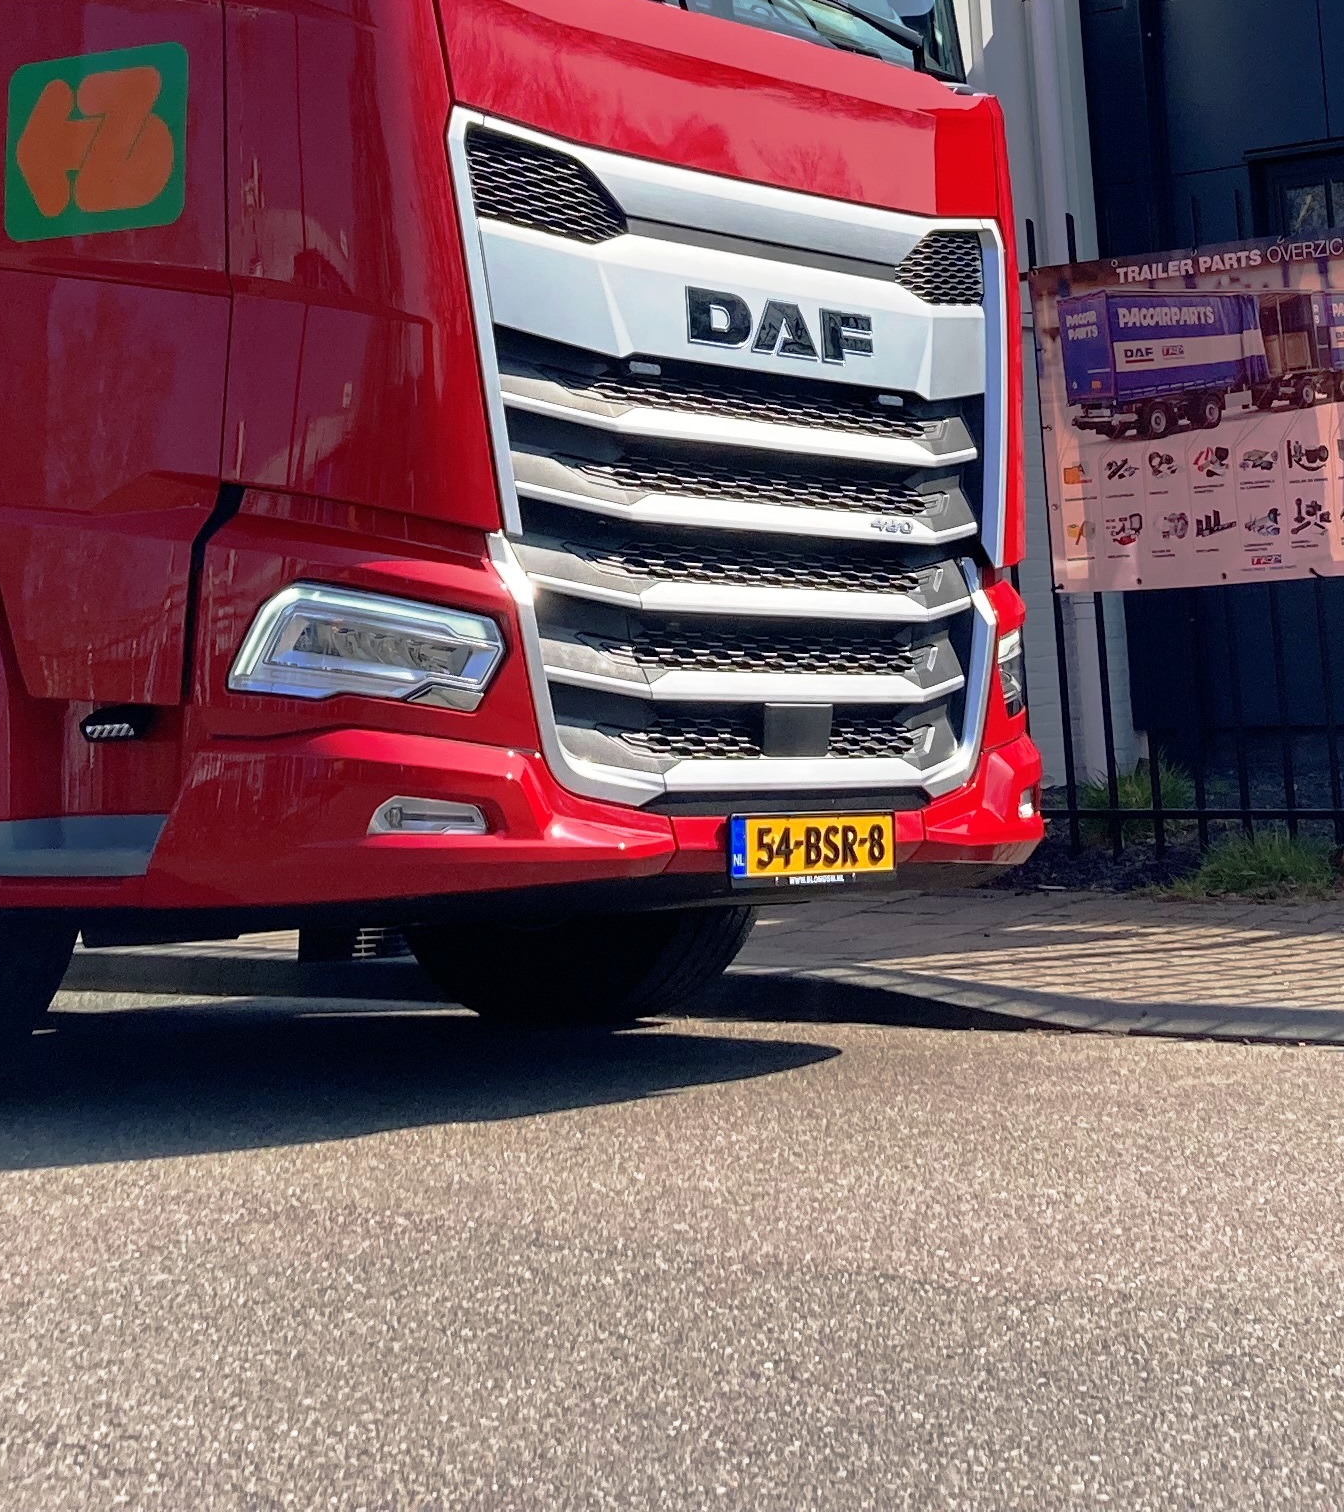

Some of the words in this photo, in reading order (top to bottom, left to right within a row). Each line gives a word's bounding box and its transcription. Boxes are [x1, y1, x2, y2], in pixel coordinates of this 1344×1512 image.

[1115, 258, 1195, 284] TRAILER
[1198, 249, 1262, 273] PARTS
[684, 285, 875, 367] DAF
[1123, 347, 1154, 358] DAF
[733, 853, 745, 867] NL
[756, 823, 886, 870] 54-BSR-8
